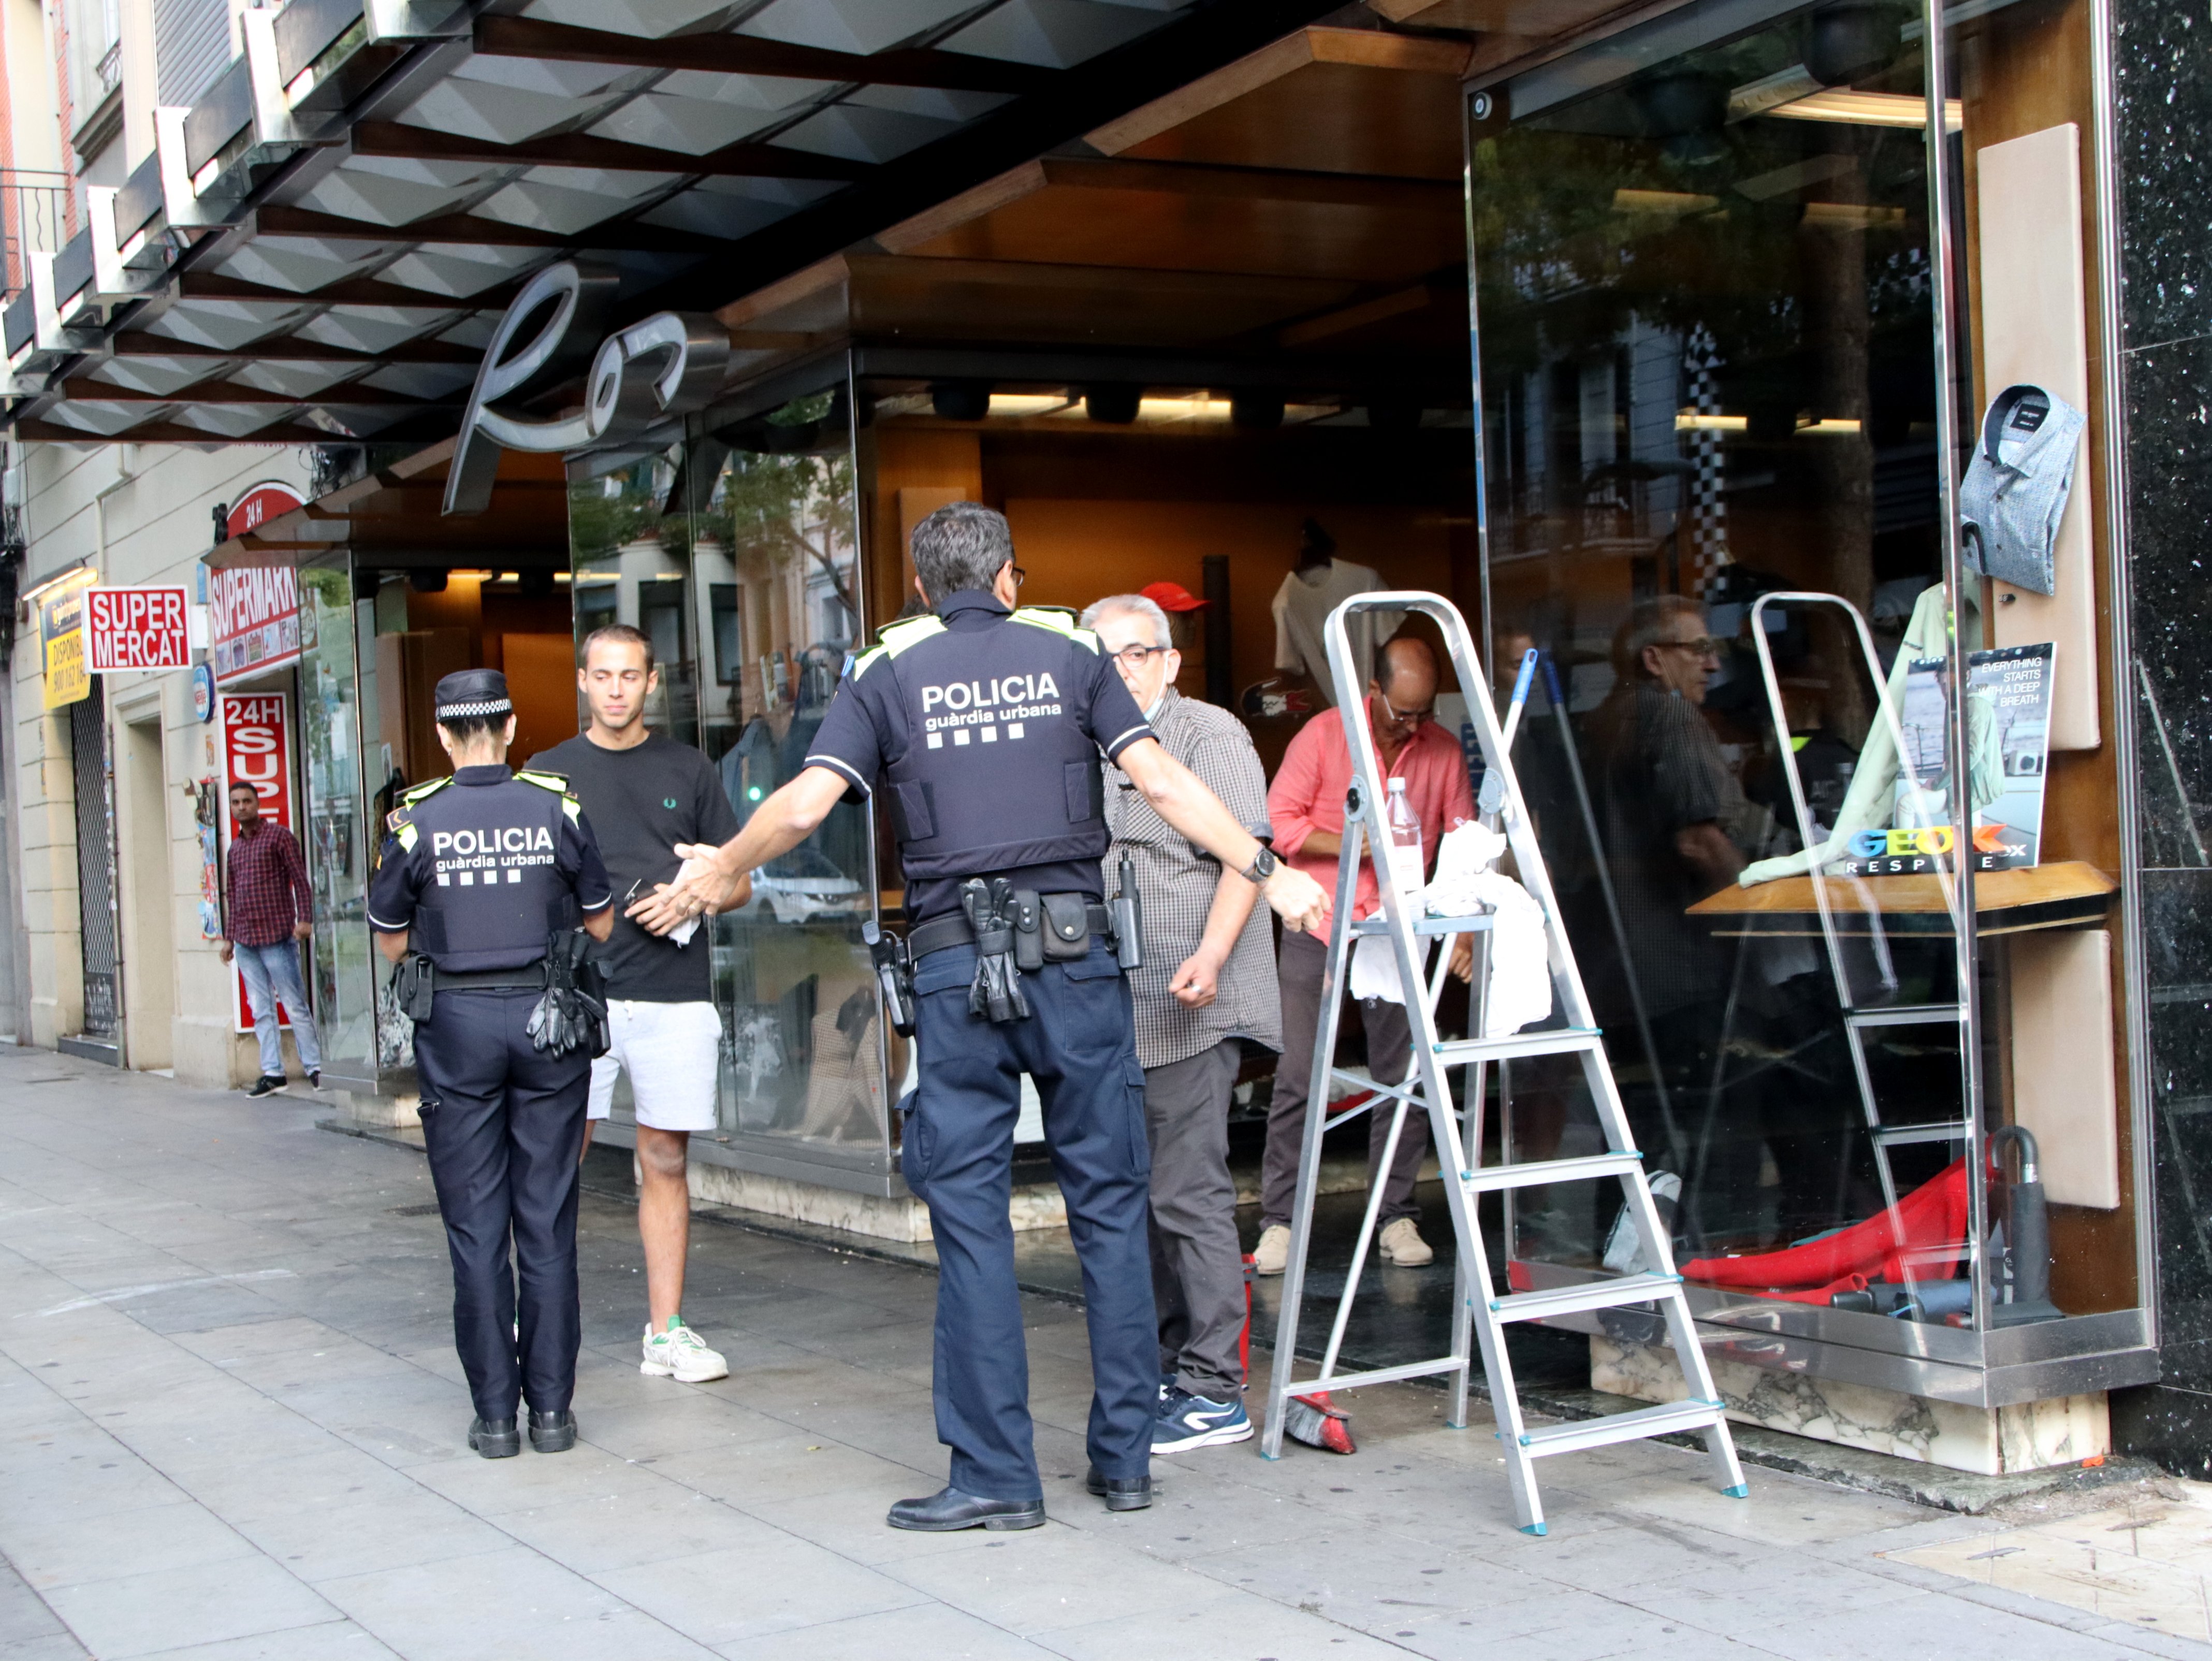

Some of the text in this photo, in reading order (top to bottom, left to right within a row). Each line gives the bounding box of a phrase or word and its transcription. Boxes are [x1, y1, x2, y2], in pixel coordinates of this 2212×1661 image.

[246, 502, 255, 529] 24
[93, 593, 184, 631] SUPER
[212, 567, 300, 640] SUPERMARK
[53, 635, 83, 666] DISPONIBL
[94, 629, 184, 667] MERCAT
[1982, 657, 2042, 673] EVERYTHING
[2003, 669, 2041, 683] STARTS
[922, 673, 1060, 713] POLICIA
[1978, 682, 2041, 697] WITH A DEEP
[2000, 695, 2039, 707] BREATH
[225, 700, 281, 725] 24H
[925, 704, 1061, 732] guàrdia urbana
[433, 827, 555, 856] POLICIA
[436, 854, 555, 872] guàrdia urbana
[1845, 856, 1993, 874] RESPIE
